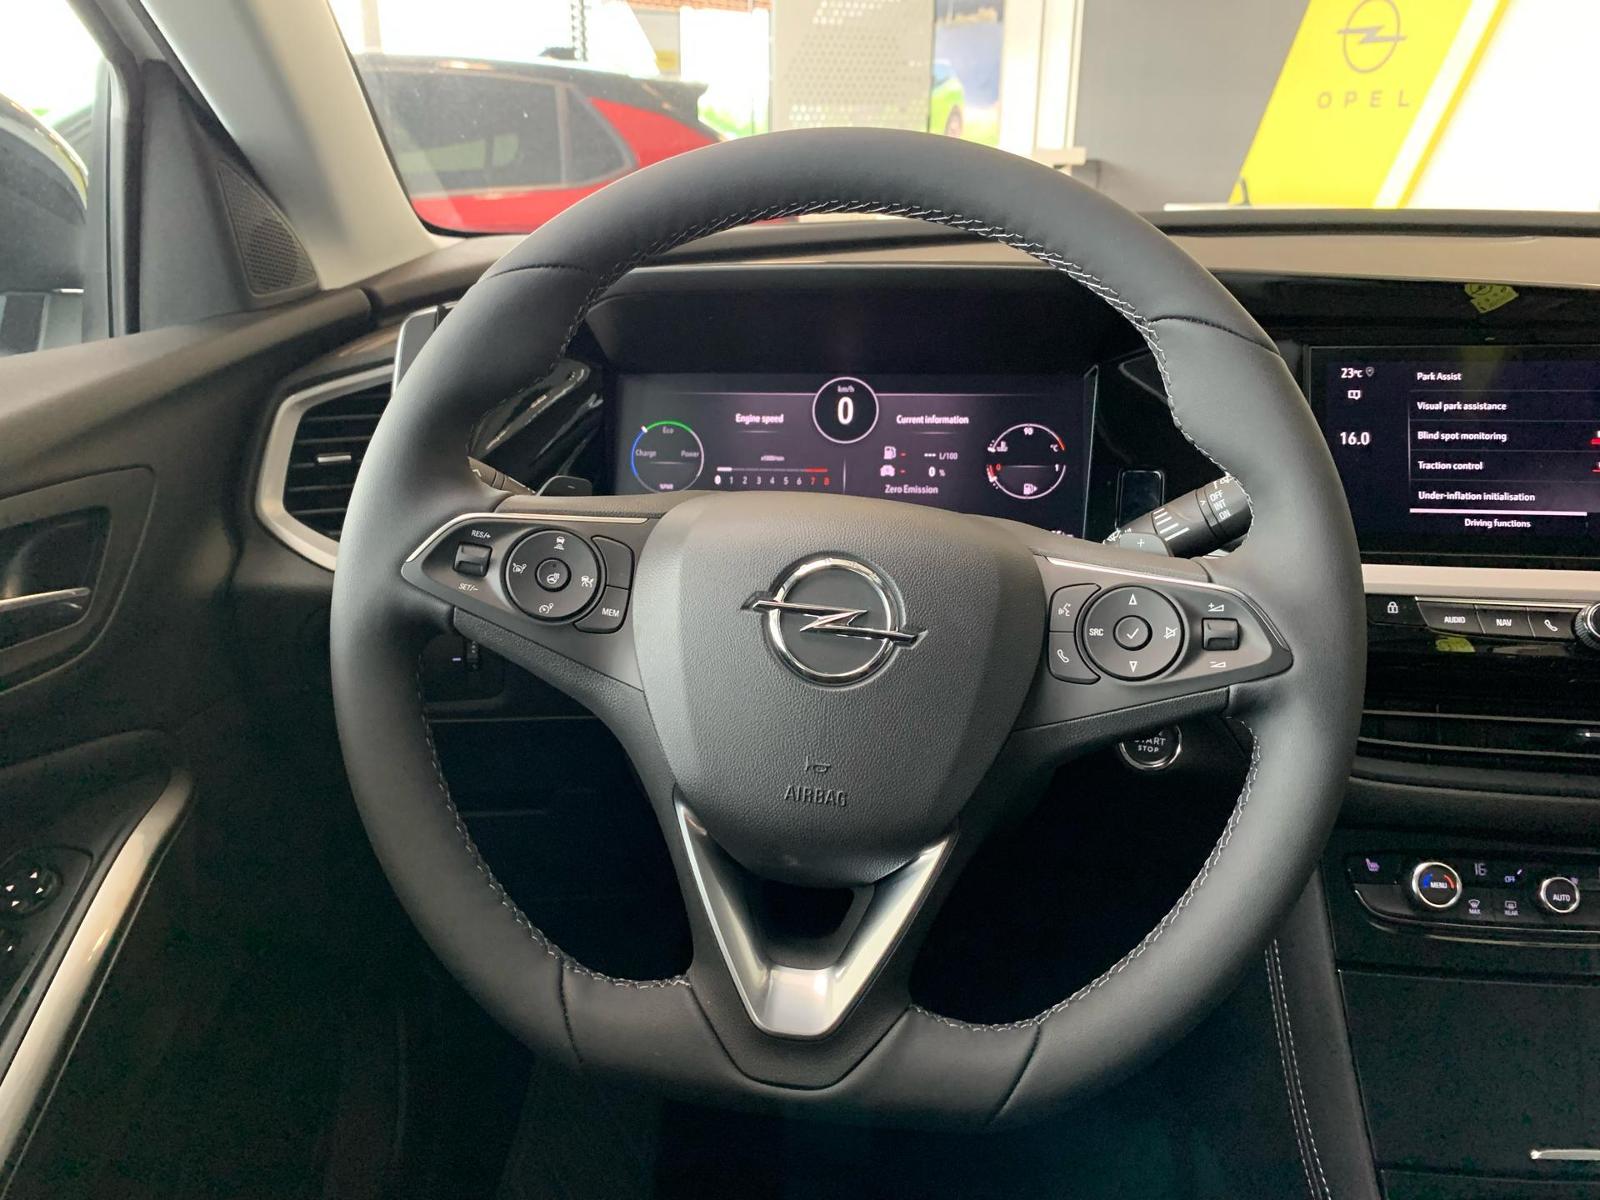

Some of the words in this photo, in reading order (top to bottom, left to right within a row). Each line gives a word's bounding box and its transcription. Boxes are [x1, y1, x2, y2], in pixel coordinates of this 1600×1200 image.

[1317, 90, 1409, 109] OPEL
[1416, 372, 1435, 381] Park
[1436, 372, 1462, 381] Assist
[837, 396, 854, 425] 0
[1416, 401, 1442, 411] Visual
[1443, 401, 1462, 413] park
[1463, 401, 1507, 411] assistance
[735, 413, 760, 425] Engine
[761, 413, 784, 425] speed
[896, 414, 924, 424] Current
[925, 414, 969, 425] information
[1340, 431, 1371, 446] 16.0
[1417, 431, 1439, 441] Blind
[1440, 432, 1459, 442] spot
[1460, 431, 1507, 443] monitoring
[635, 448, 657, 458] Charge
[681, 449, 699, 458] Power
[1418, 461, 1451, 470] Traction
[1453, 461, 1483, 470] control
[928, 466, 936, 477] 0
[742, 476, 748, 485] 2
[757, 476, 762, 485] 3
[769, 476, 775, 485] 4
[783, 476, 789, 485] 5
[797, 476, 802, 486] 6
[811, 476, 816, 486] 7
[885, 484, 903, 494] Zero
[904, 484, 939, 495] Emission
[1418, 491, 1482, 500] Under-inflation
[1483, 491, 1535, 501] initialisation
[1464, 518, 1492, 529] Driving
[1493, 518, 1531, 528] functions
[602, 608, 620, 617] MEM
[1444, 615, 1466, 624] AUDIO
[1496, 619, 1512, 627] NAV
[1089, 628, 1104, 637] SRC
[1138, 745, 1159, 753] STOP
[784, 785, 847, 807] AIRBAG
[1430, 881, 1447, 889] MENU
[1552, 894, 1570, 902] AUTO
